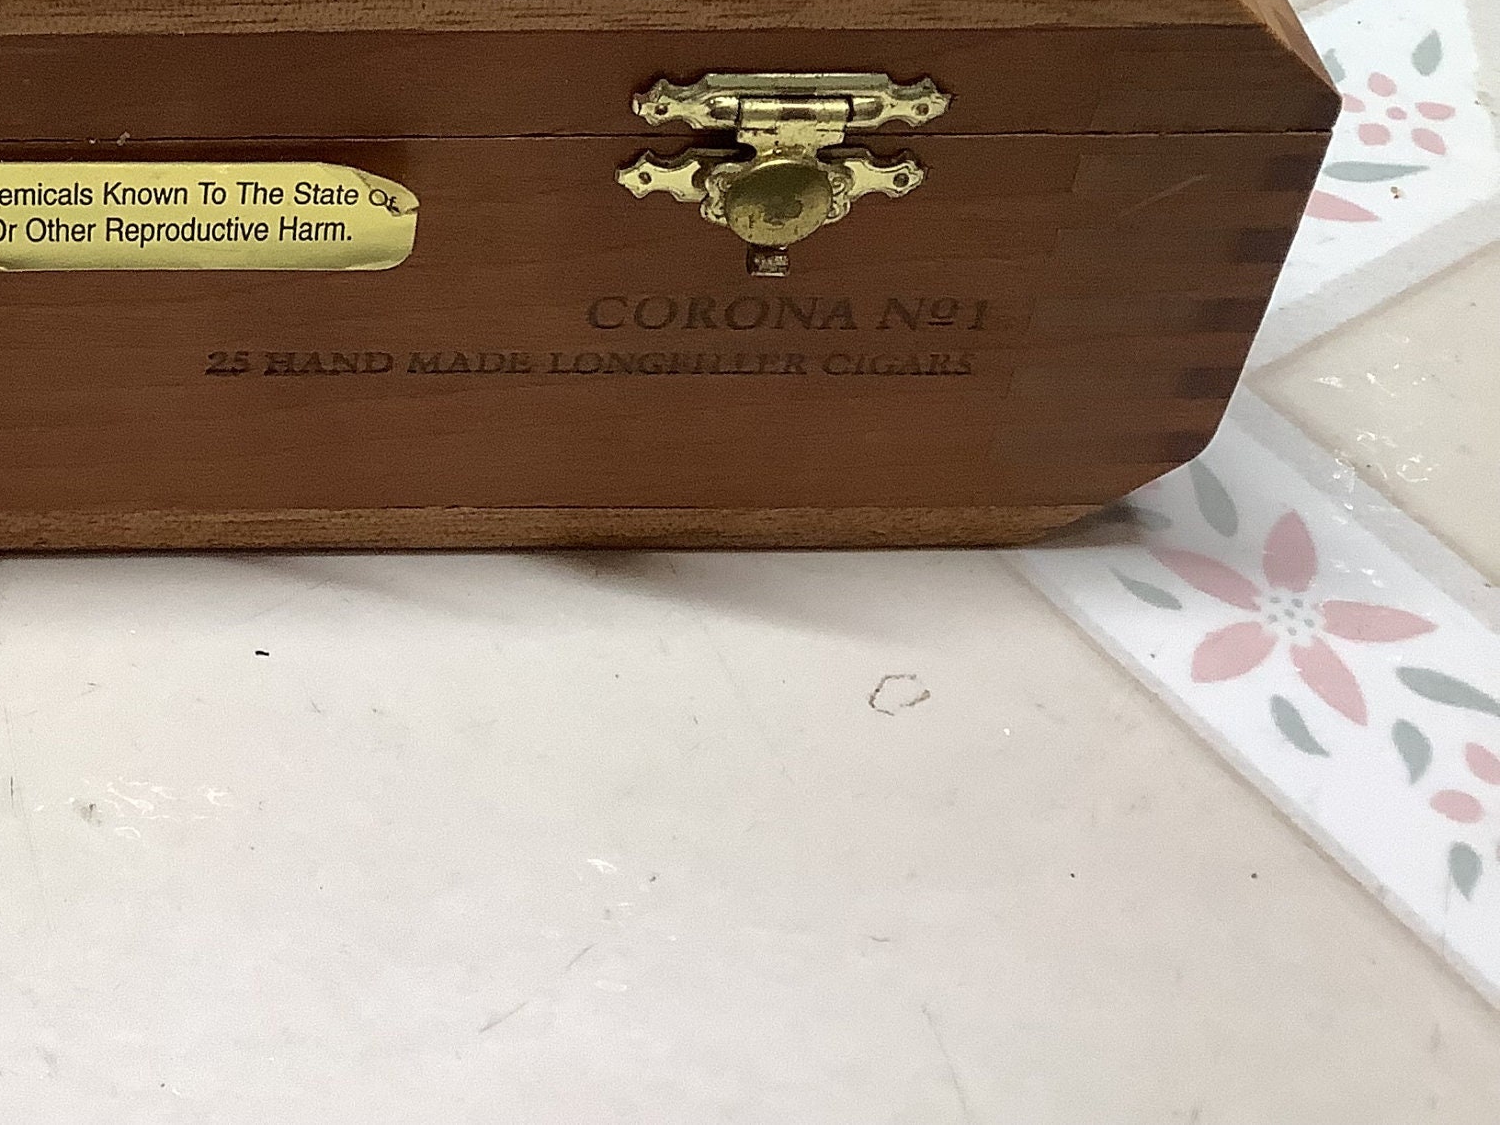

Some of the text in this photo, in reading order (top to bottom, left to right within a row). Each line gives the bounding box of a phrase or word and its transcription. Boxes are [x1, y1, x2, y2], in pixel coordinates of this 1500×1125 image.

[103, 181, 188, 205] Known
[198, 181, 227, 205] To
[236, 181, 284, 205] The
[293, 181, 359, 205] State
[25, 217, 96, 243] Other
[105, 216, 270, 248] Reproductive
[278, 215, 353, 242] Harm.
[585, 295, 858, 331] CORONA
[204, 350, 250, 376] 25
[263, 350, 394, 376] HAND
[405, 350, 532, 375] MADE
[820, 351, 978, 376] CIGARS
